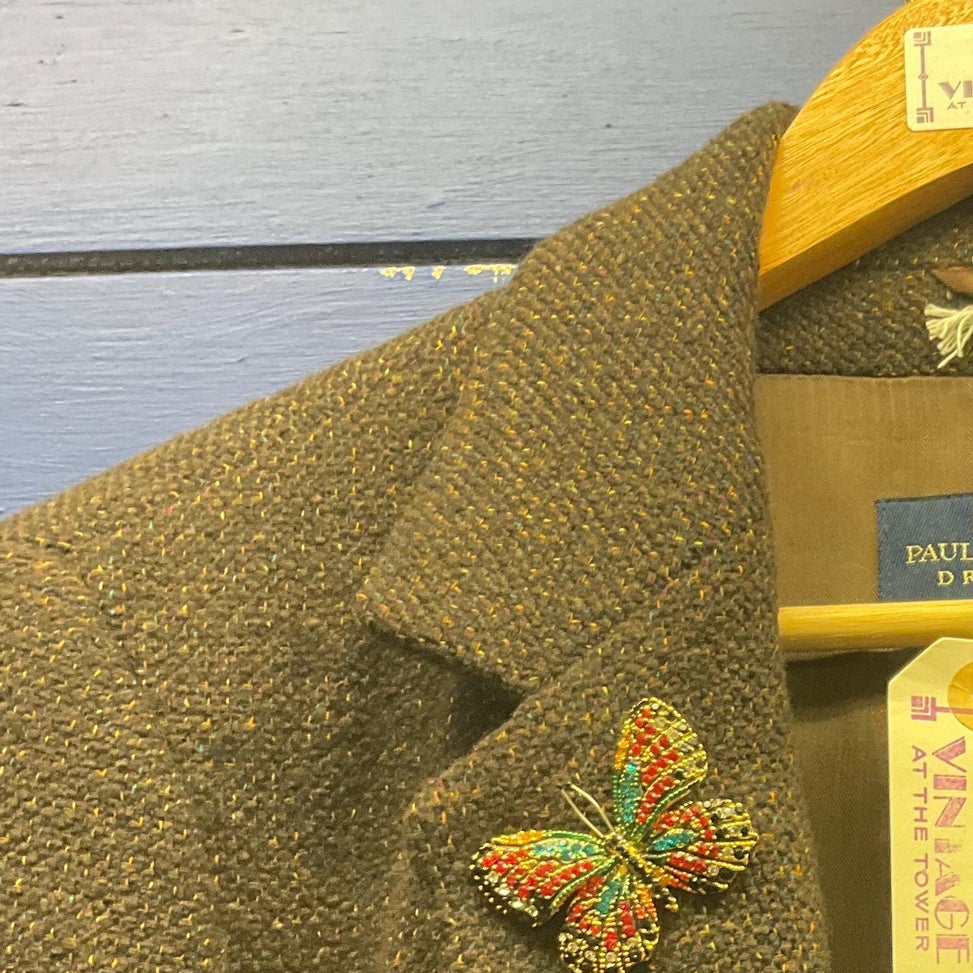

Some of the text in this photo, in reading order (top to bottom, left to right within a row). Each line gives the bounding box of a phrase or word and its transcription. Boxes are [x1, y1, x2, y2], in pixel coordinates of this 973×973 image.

[947, 101, 967, 110] AT
[912, 745, 929, 951] AT THE TOWER
